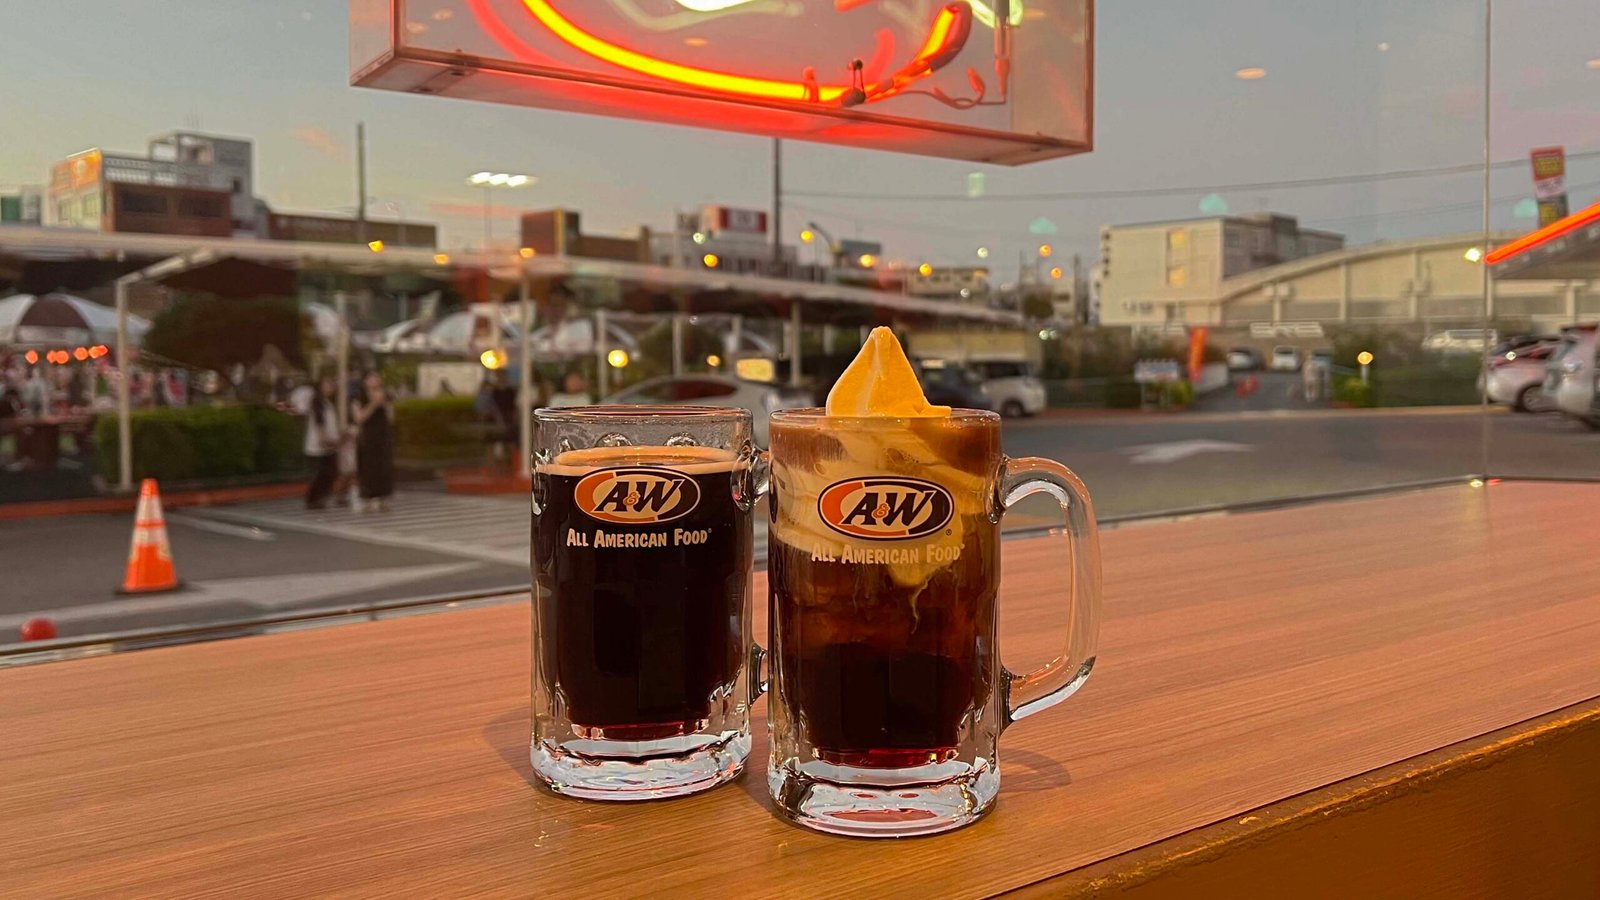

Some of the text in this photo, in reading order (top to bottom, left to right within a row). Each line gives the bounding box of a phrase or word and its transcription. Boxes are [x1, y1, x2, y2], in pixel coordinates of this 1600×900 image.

[590, 479, 685, 513] A&W
[838, 490, 937, 527] A&W
[566, 527, 589, 547] ALL
[594, 529, 667, 548] AMERICAN
[811, 543, 836, 562] ALL
[841, 543, 919, 564] AMERICAN
